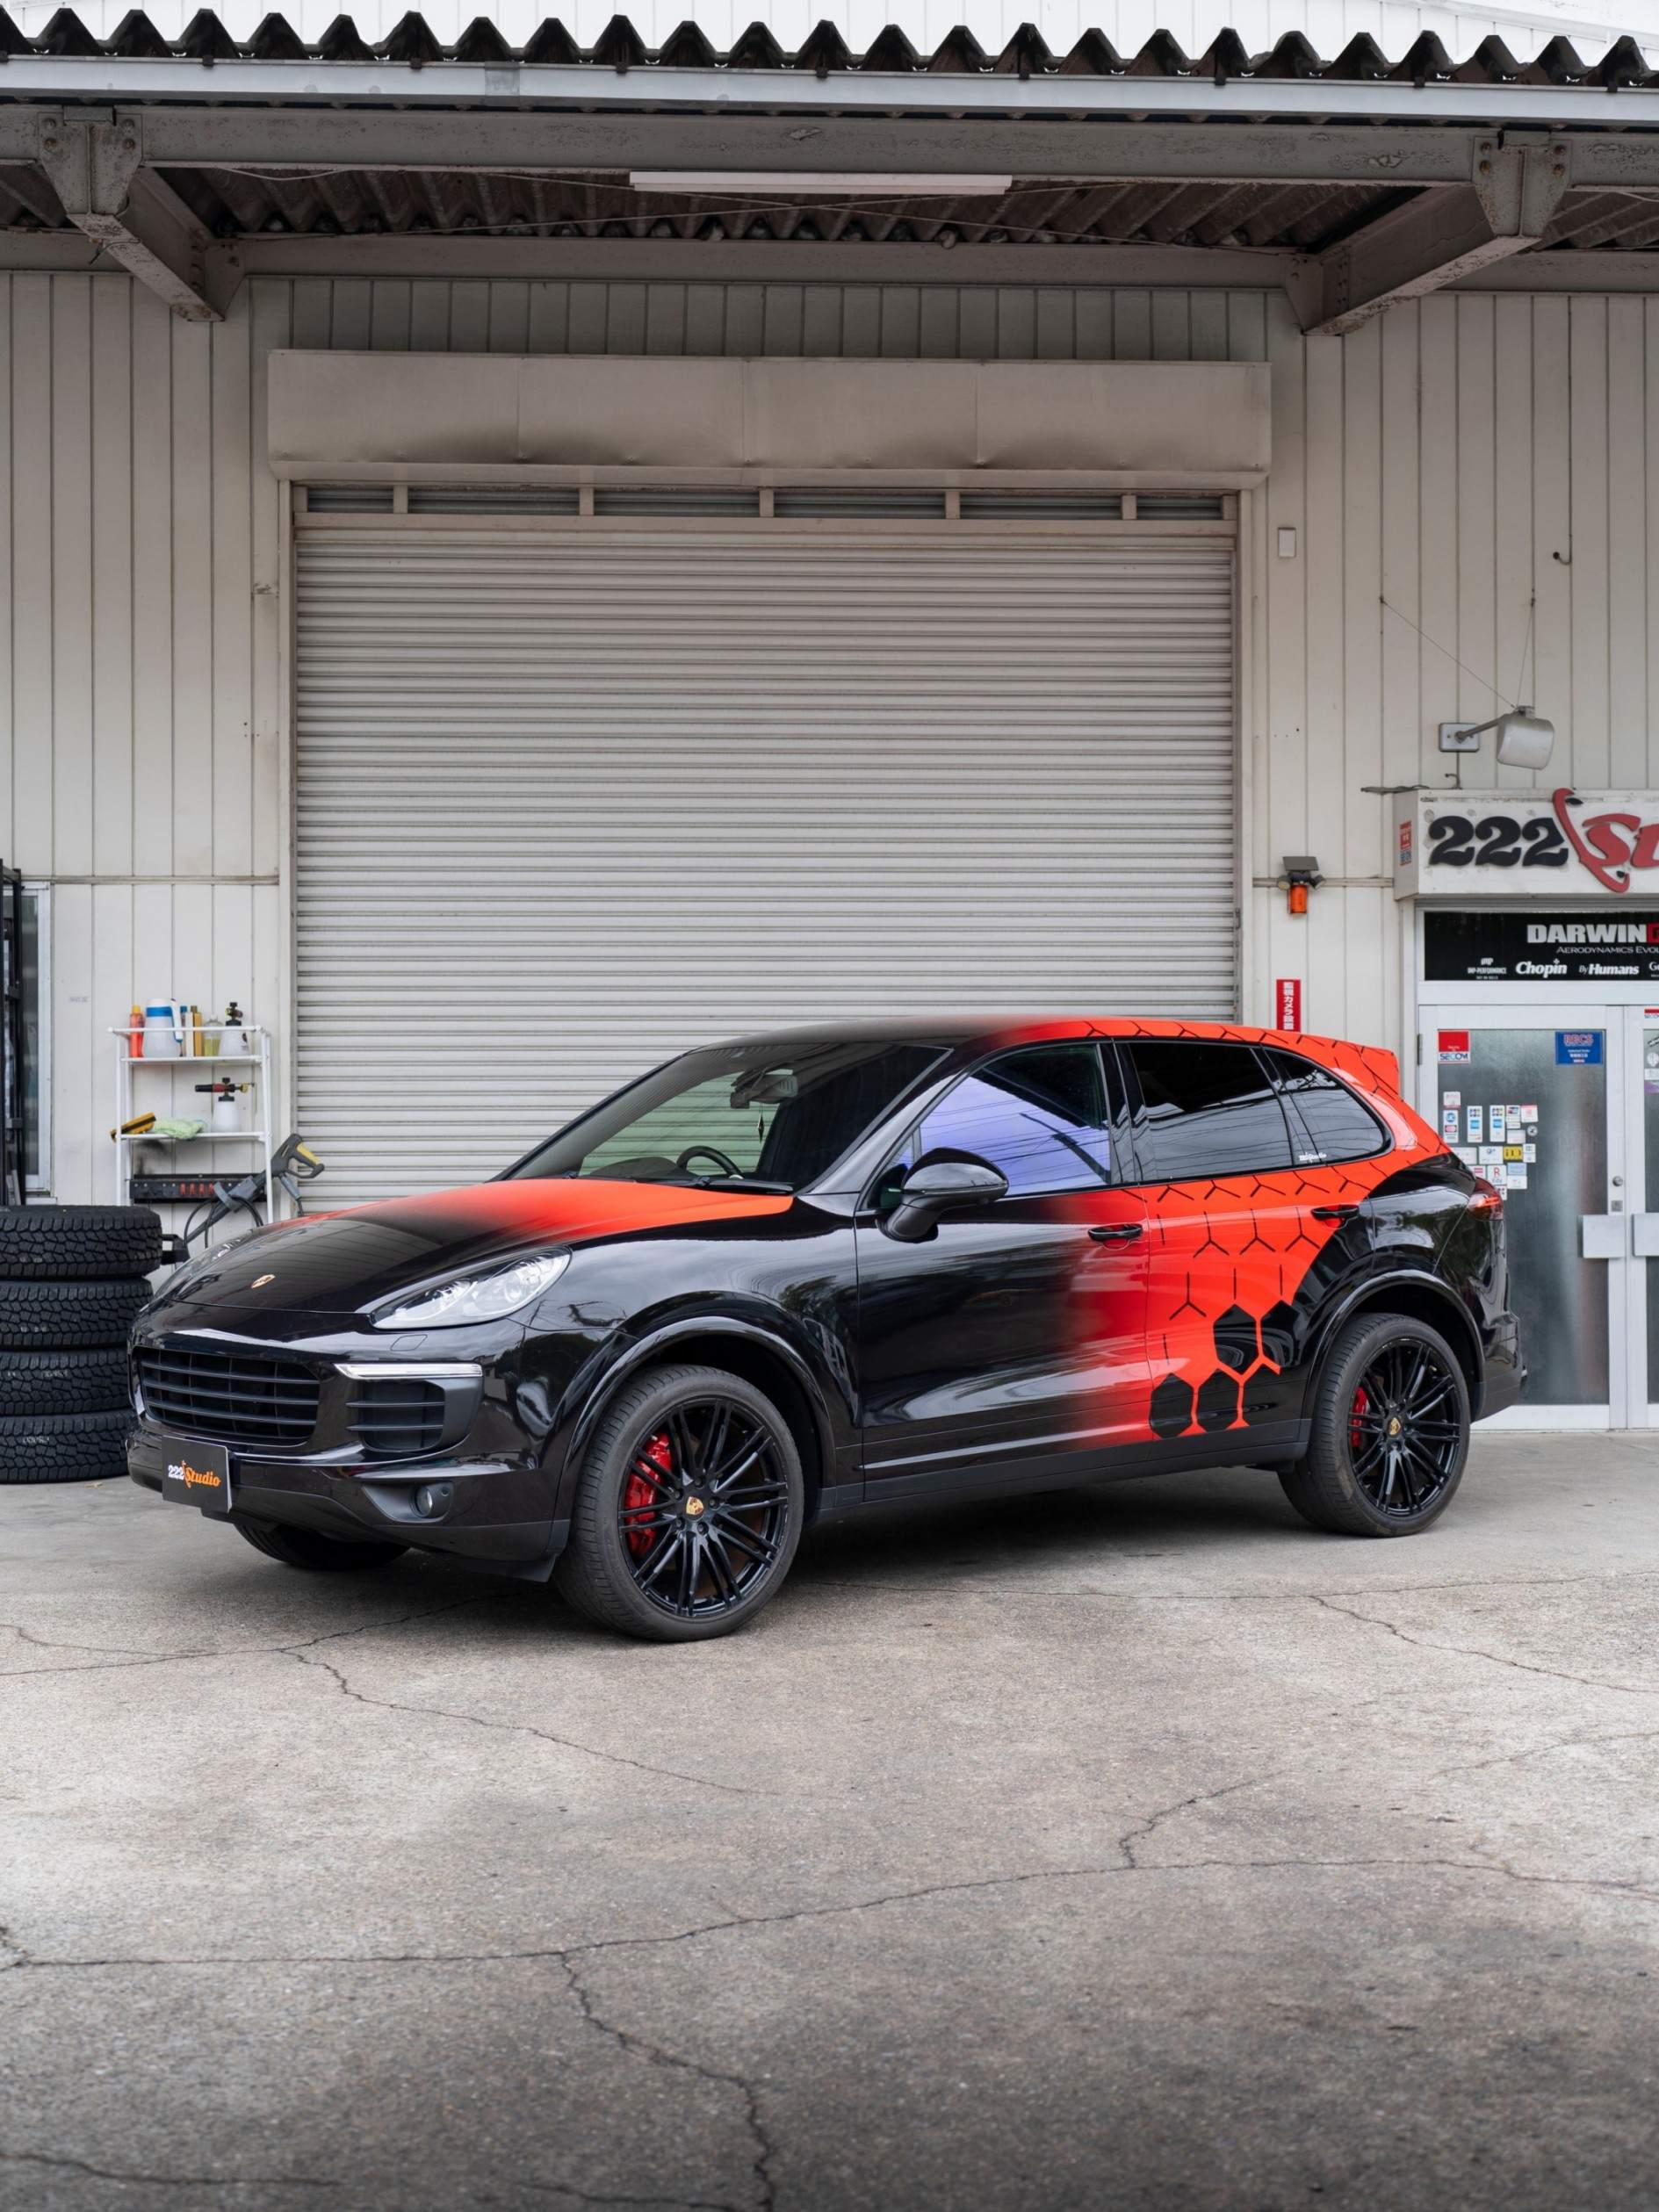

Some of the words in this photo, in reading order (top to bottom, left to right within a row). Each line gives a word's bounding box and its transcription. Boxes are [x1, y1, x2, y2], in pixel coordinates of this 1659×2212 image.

[1428, 815, 1569, 868] 222
[1515, 958, 1568, 979] Chopin
[1588, 963, 1640, 976] Humans
[1439, 1052, 1469, 1061] SECOM
[181, 1459, 221, 1489] Studio
